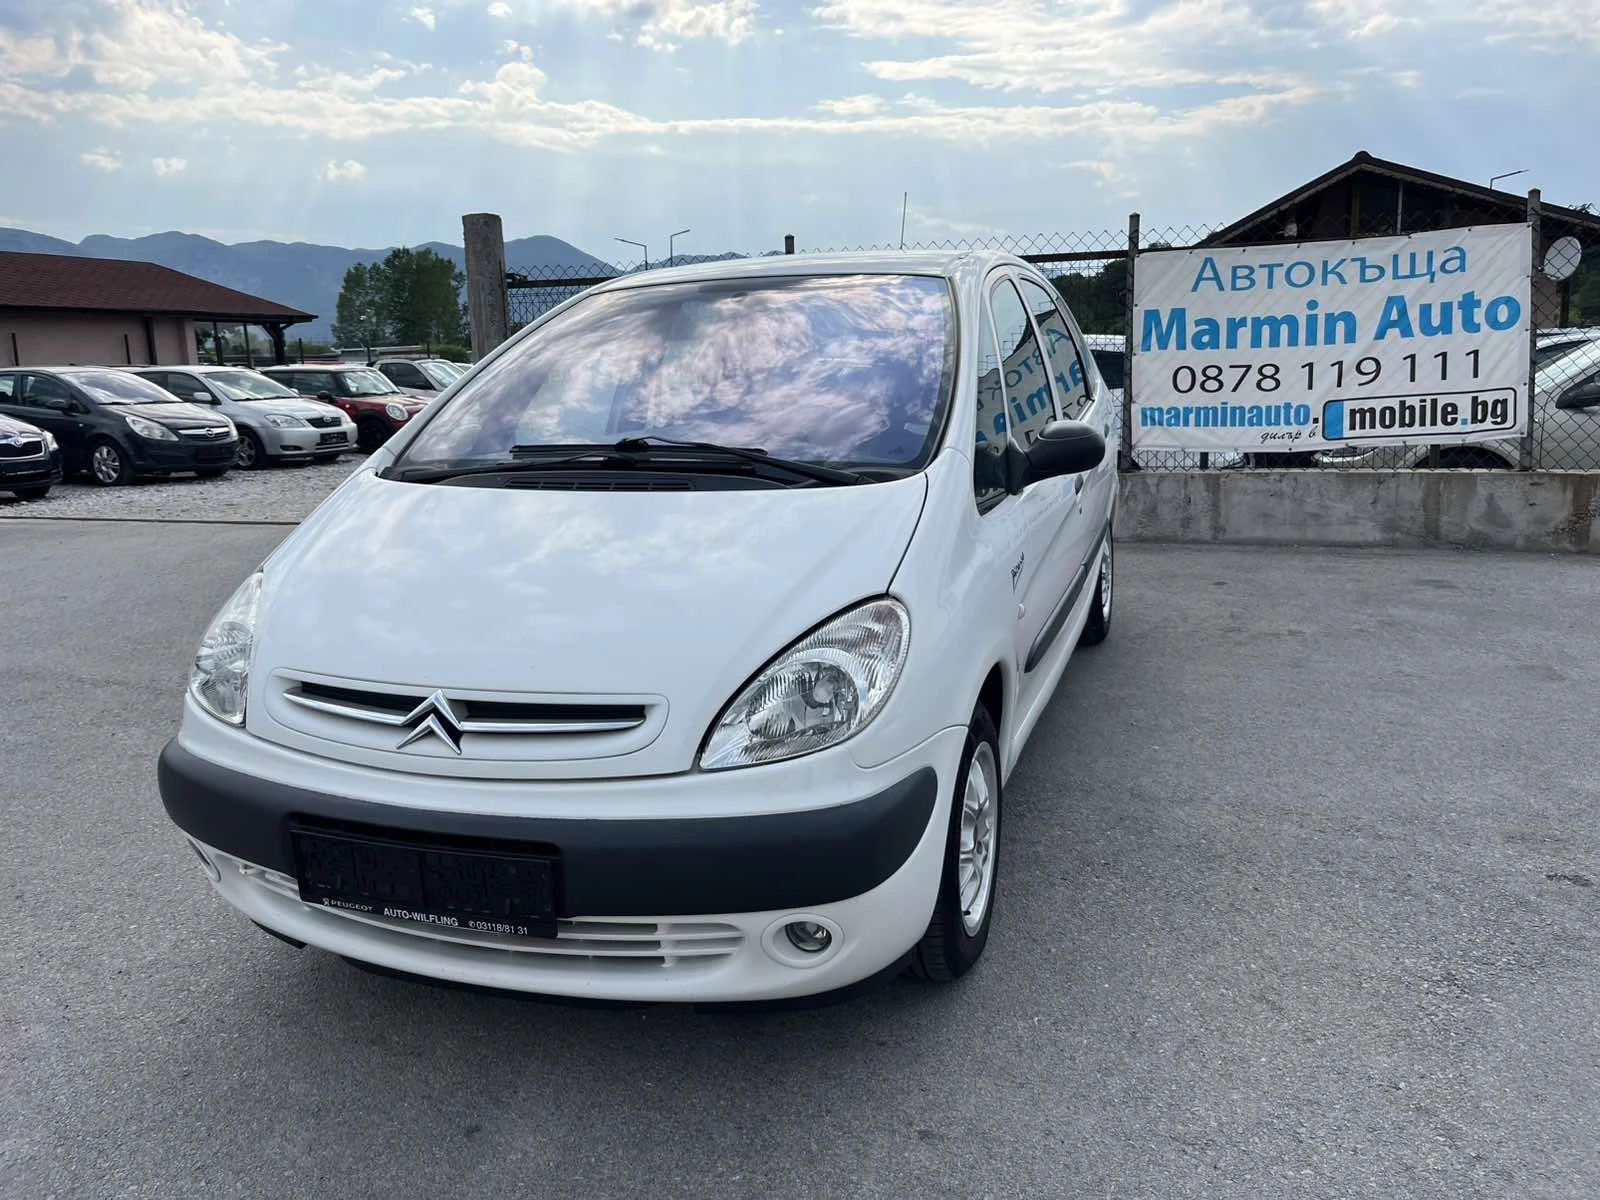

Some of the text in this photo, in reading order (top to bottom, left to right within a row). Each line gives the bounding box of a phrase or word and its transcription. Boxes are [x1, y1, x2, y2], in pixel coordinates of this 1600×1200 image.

[1191, 245, 1467, 293] Автокъща
[1141, 290, 1522, 353] Marmin Auto
[1171, 348, 1481, 394] 0878 119 111
[1349, 396, 1508, 431] mobile.bg
[1260, 431, 1302, 444] дилър
[331, 899, 376, 911] PEUGEOT
[383, 907, 459, 927] AUTO-WILFLING
